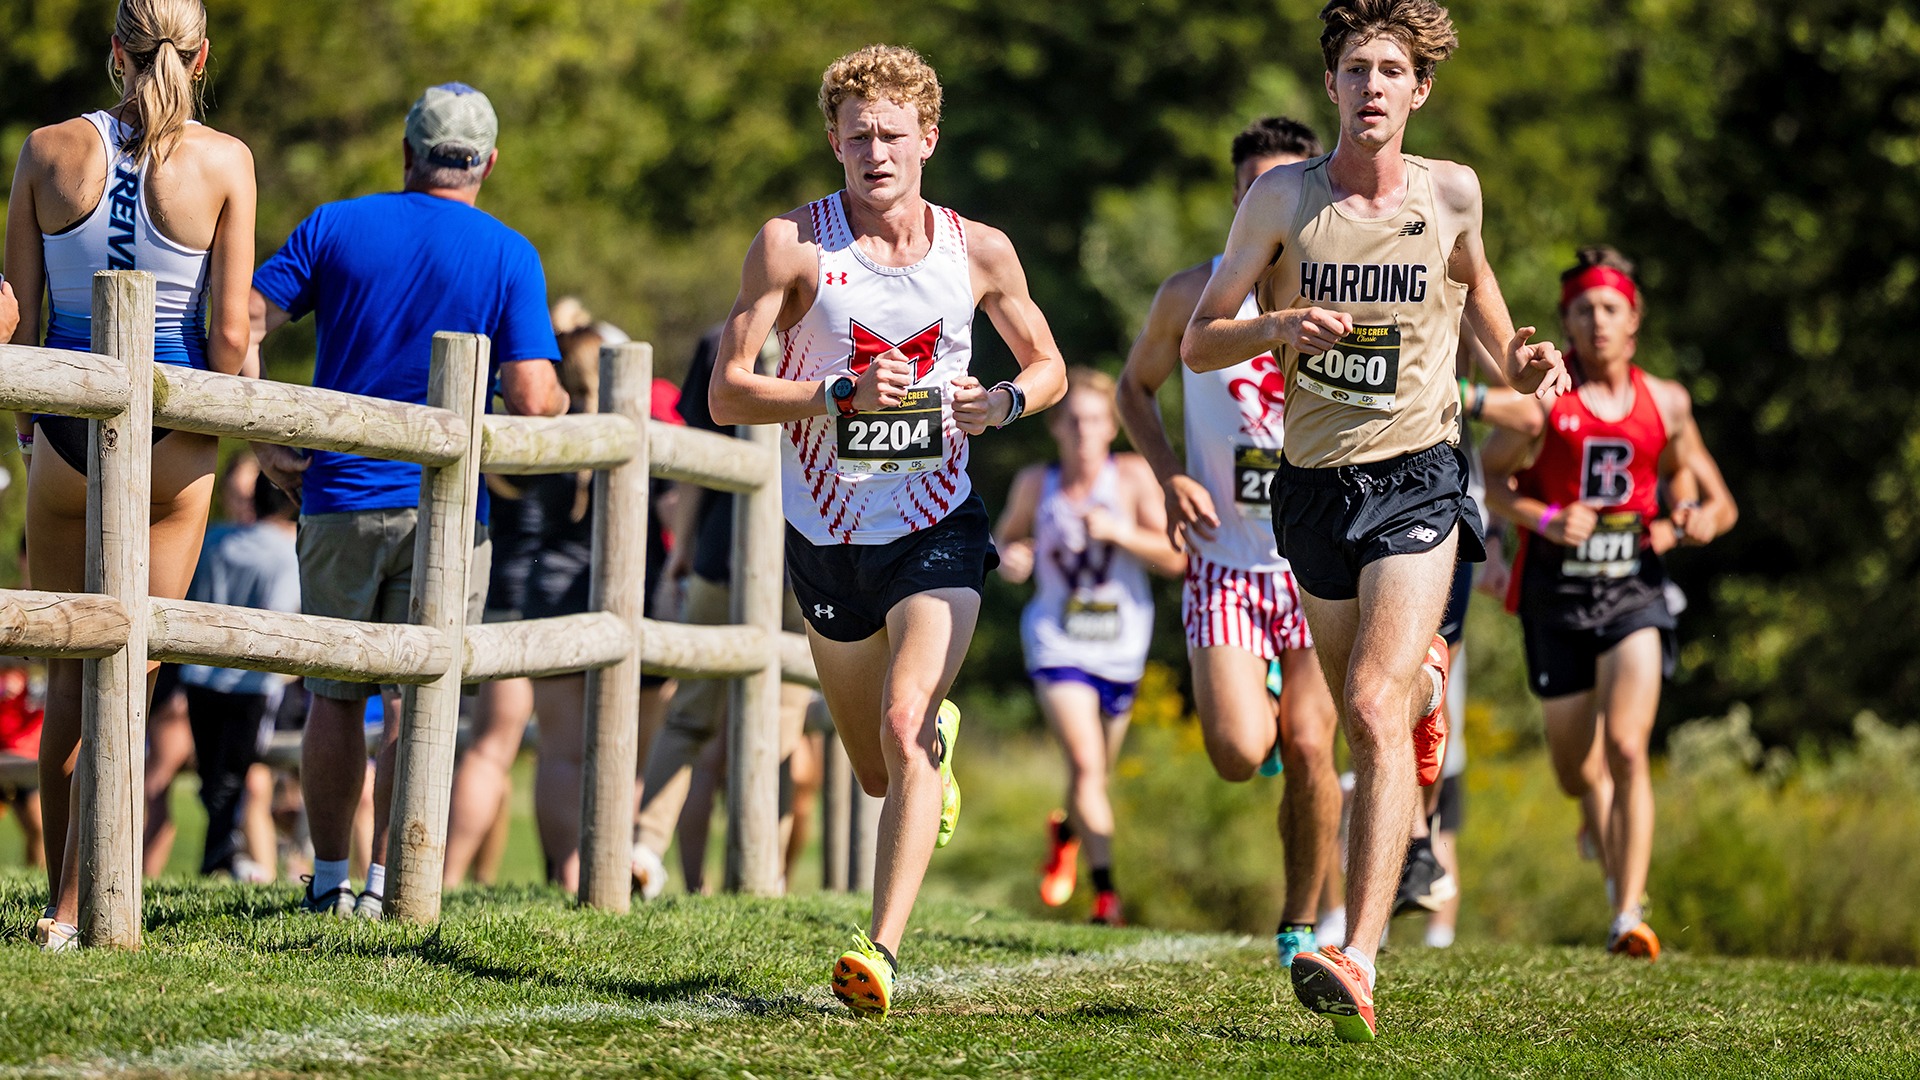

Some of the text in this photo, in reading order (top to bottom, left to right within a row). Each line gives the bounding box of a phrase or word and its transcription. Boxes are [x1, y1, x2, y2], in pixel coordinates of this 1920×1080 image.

[1300, 261, 1427, 303] HARDING
[1368, 327, 1389, 336] CREEK
[847, 317, 943, 385] M
[1306, 349, 1387, 386] 2060
[907, 390, 929, 400] CREEK
[847, 419, 931, 451] 2204
[911, 460, 922, 469] CPS
[1579, 435, 1635, 507] B
